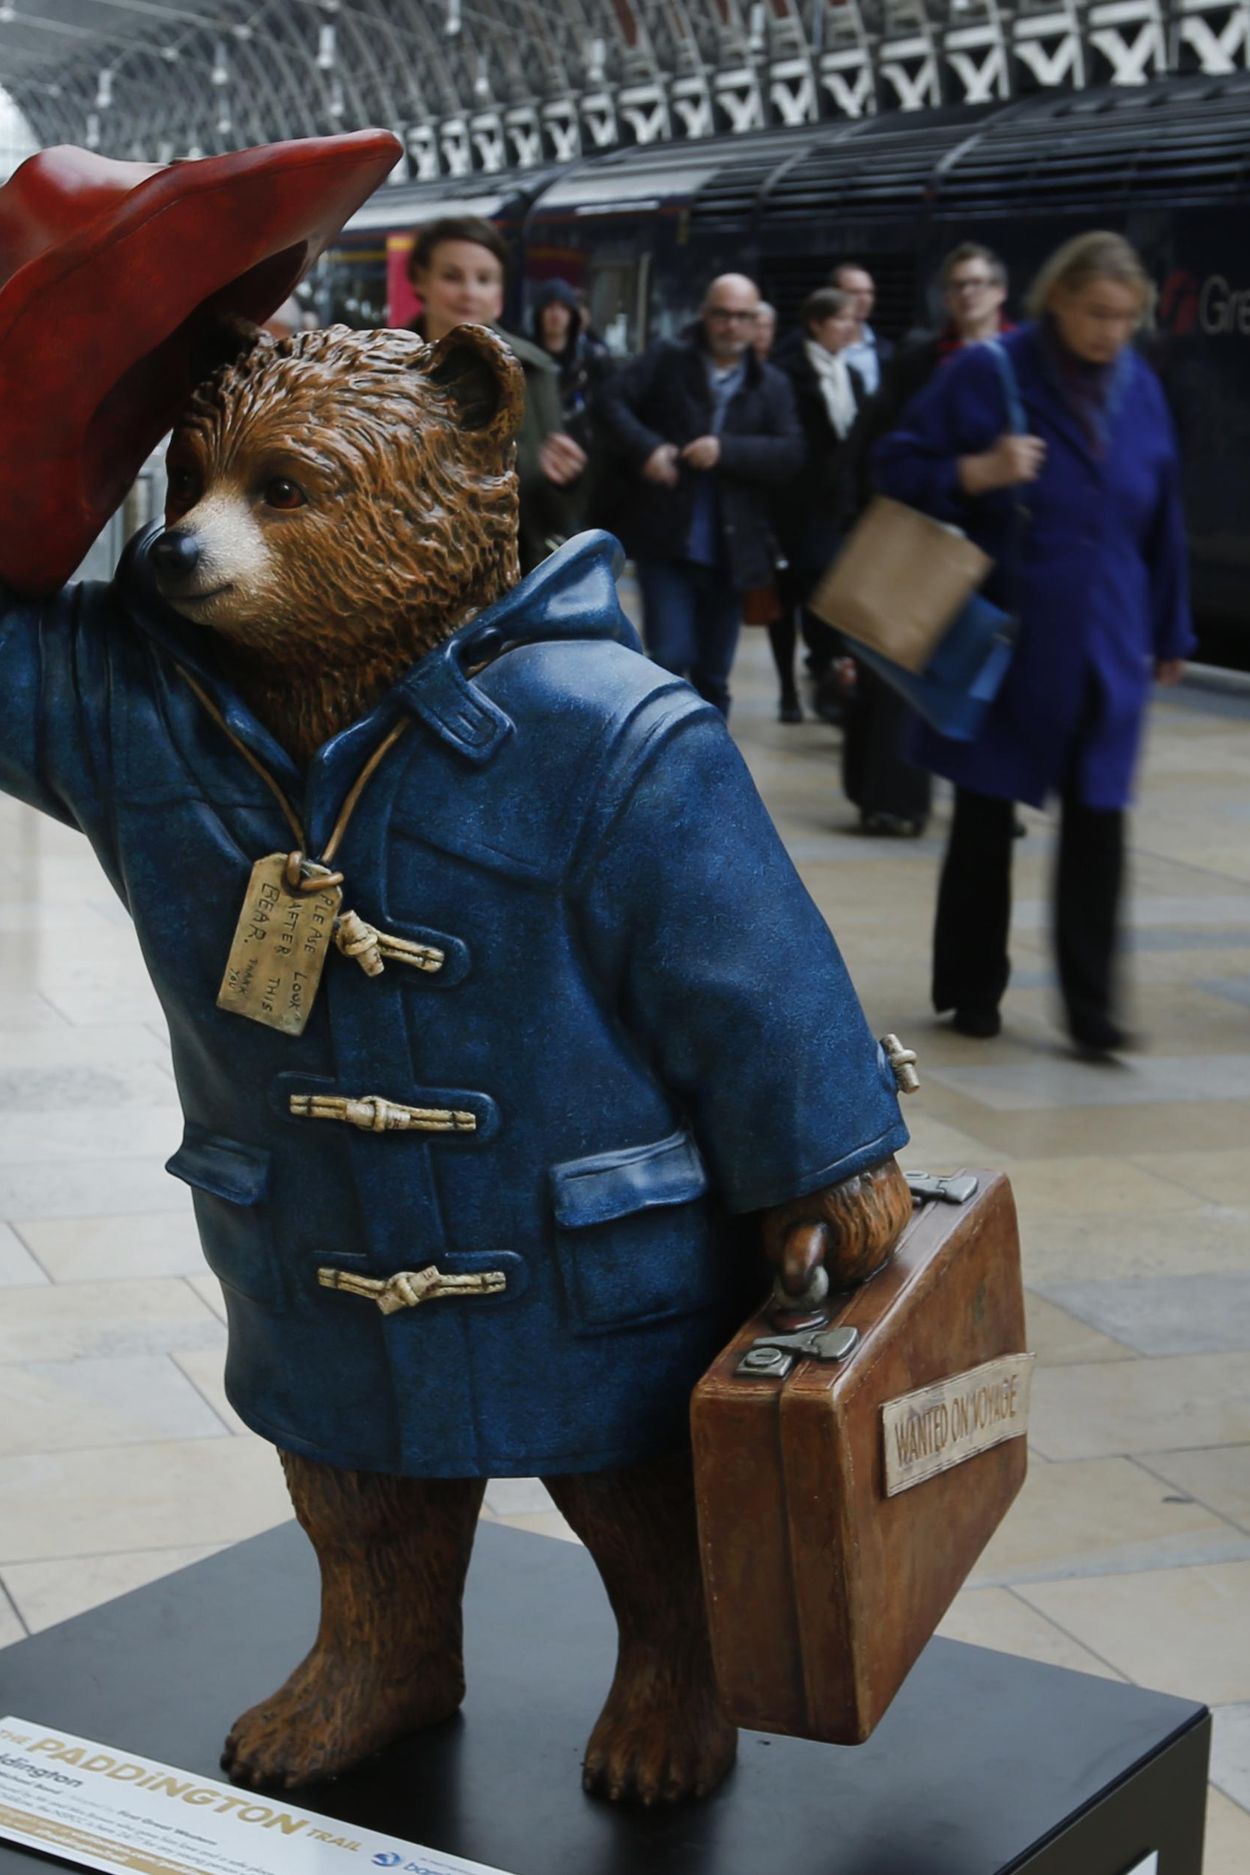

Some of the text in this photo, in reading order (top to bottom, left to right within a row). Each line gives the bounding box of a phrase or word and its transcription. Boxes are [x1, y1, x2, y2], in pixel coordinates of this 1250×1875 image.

[244, 882, 281, 944] BEAR.
[261, 901, 302, 1013] AFTER THIS
[288, 893, 334, 1009] PLEASE LOOK
[894, 1374, 1019, 1468] WANTED ON VOYAGE
[306, 1828, 362, 1852] TRAIL
